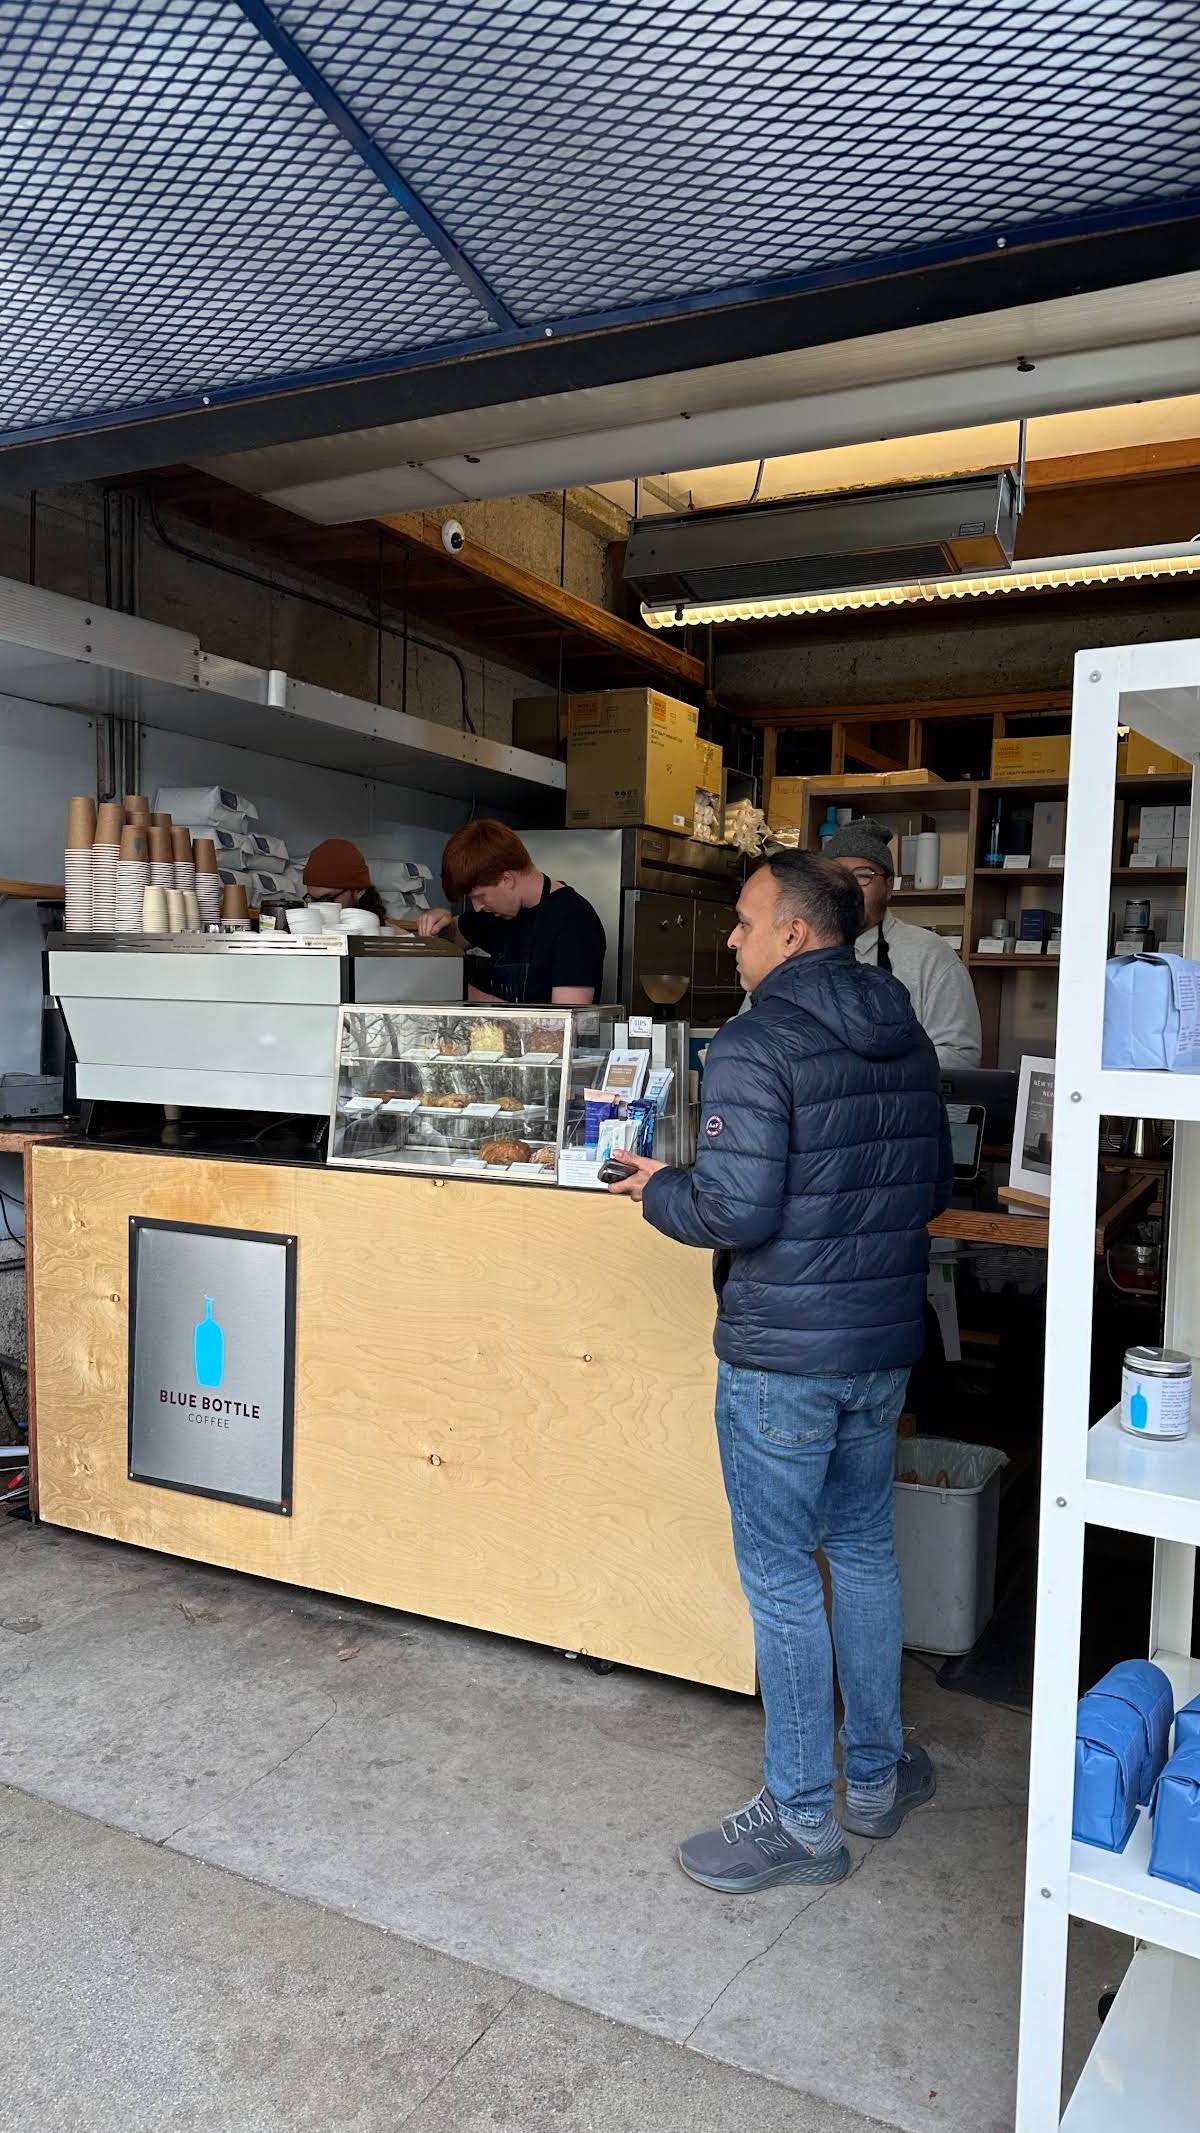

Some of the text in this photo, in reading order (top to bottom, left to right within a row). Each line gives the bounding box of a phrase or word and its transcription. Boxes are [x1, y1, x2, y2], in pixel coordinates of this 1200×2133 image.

[160, 1389, 260, 1419] BLUE BOTTLE
[188, 1413, 230, 1429] COFFEE
